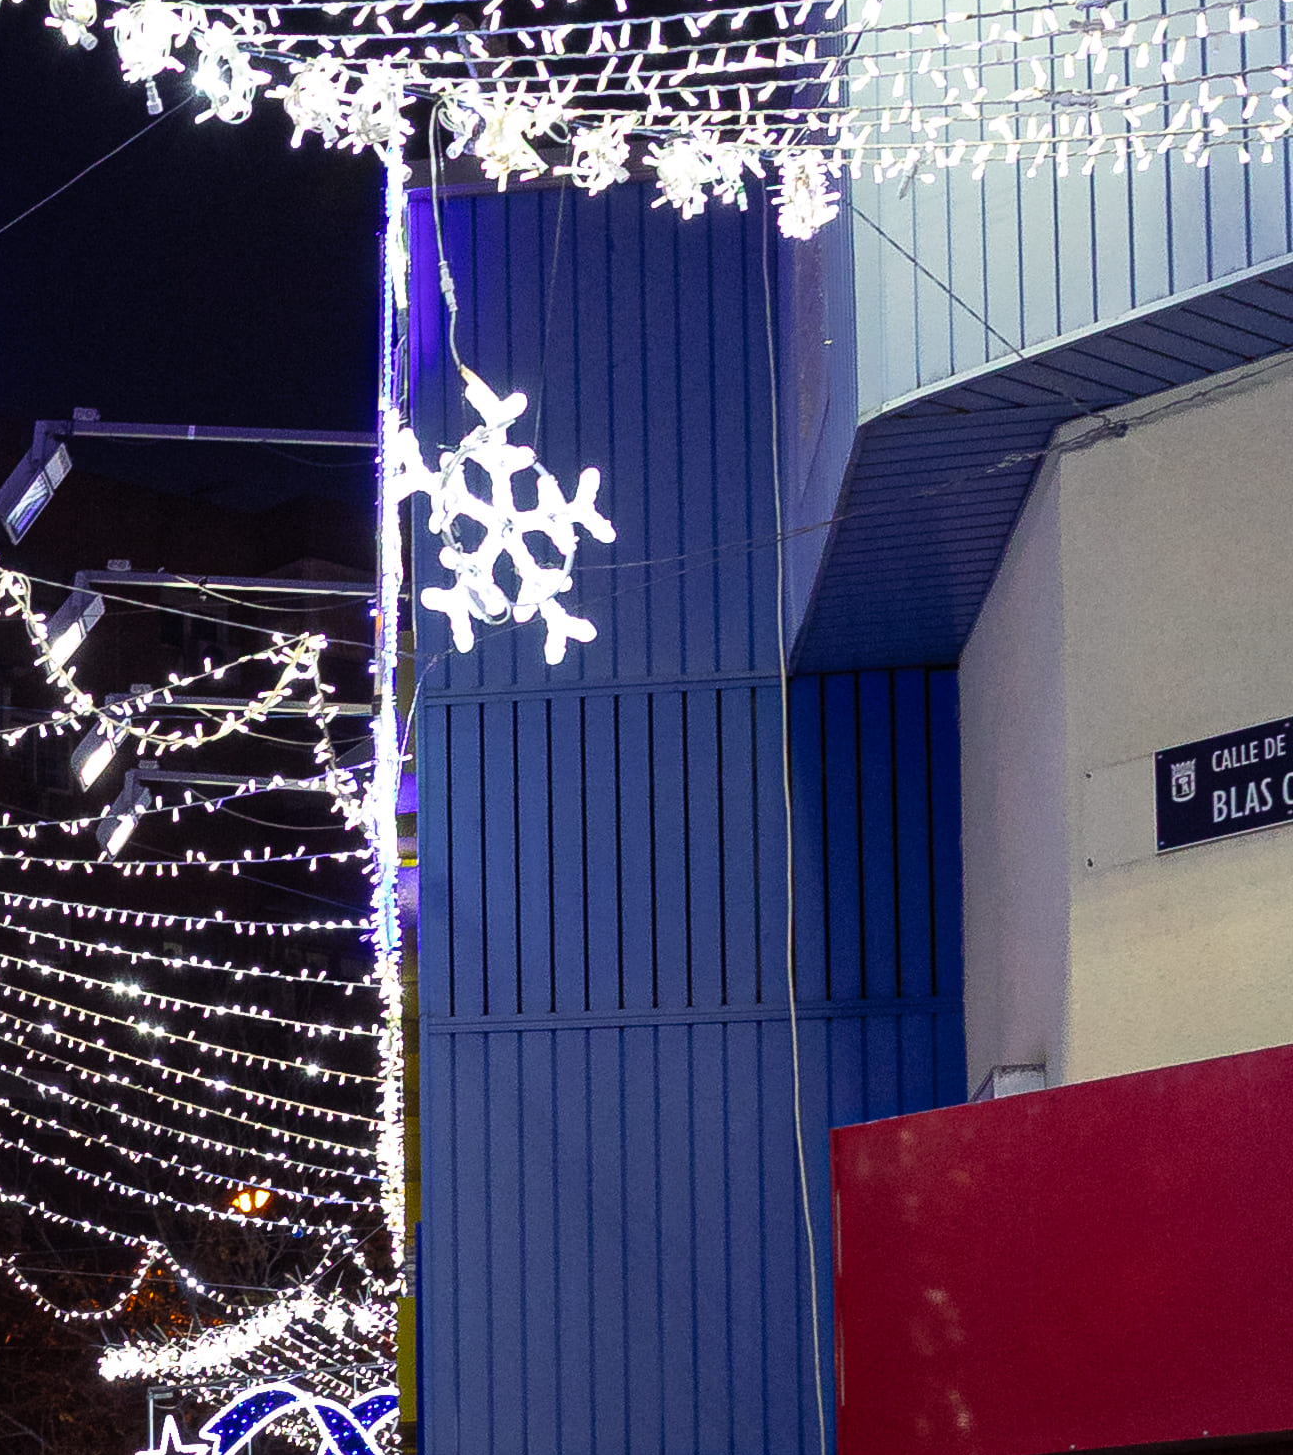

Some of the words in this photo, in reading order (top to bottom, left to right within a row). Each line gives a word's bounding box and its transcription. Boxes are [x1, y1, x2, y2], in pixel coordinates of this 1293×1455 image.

[1212, 741, 1260, 772] CALLE
[1264, 734, 1286, 760] DE
[1213, 777, 1273, 823] BLAS
